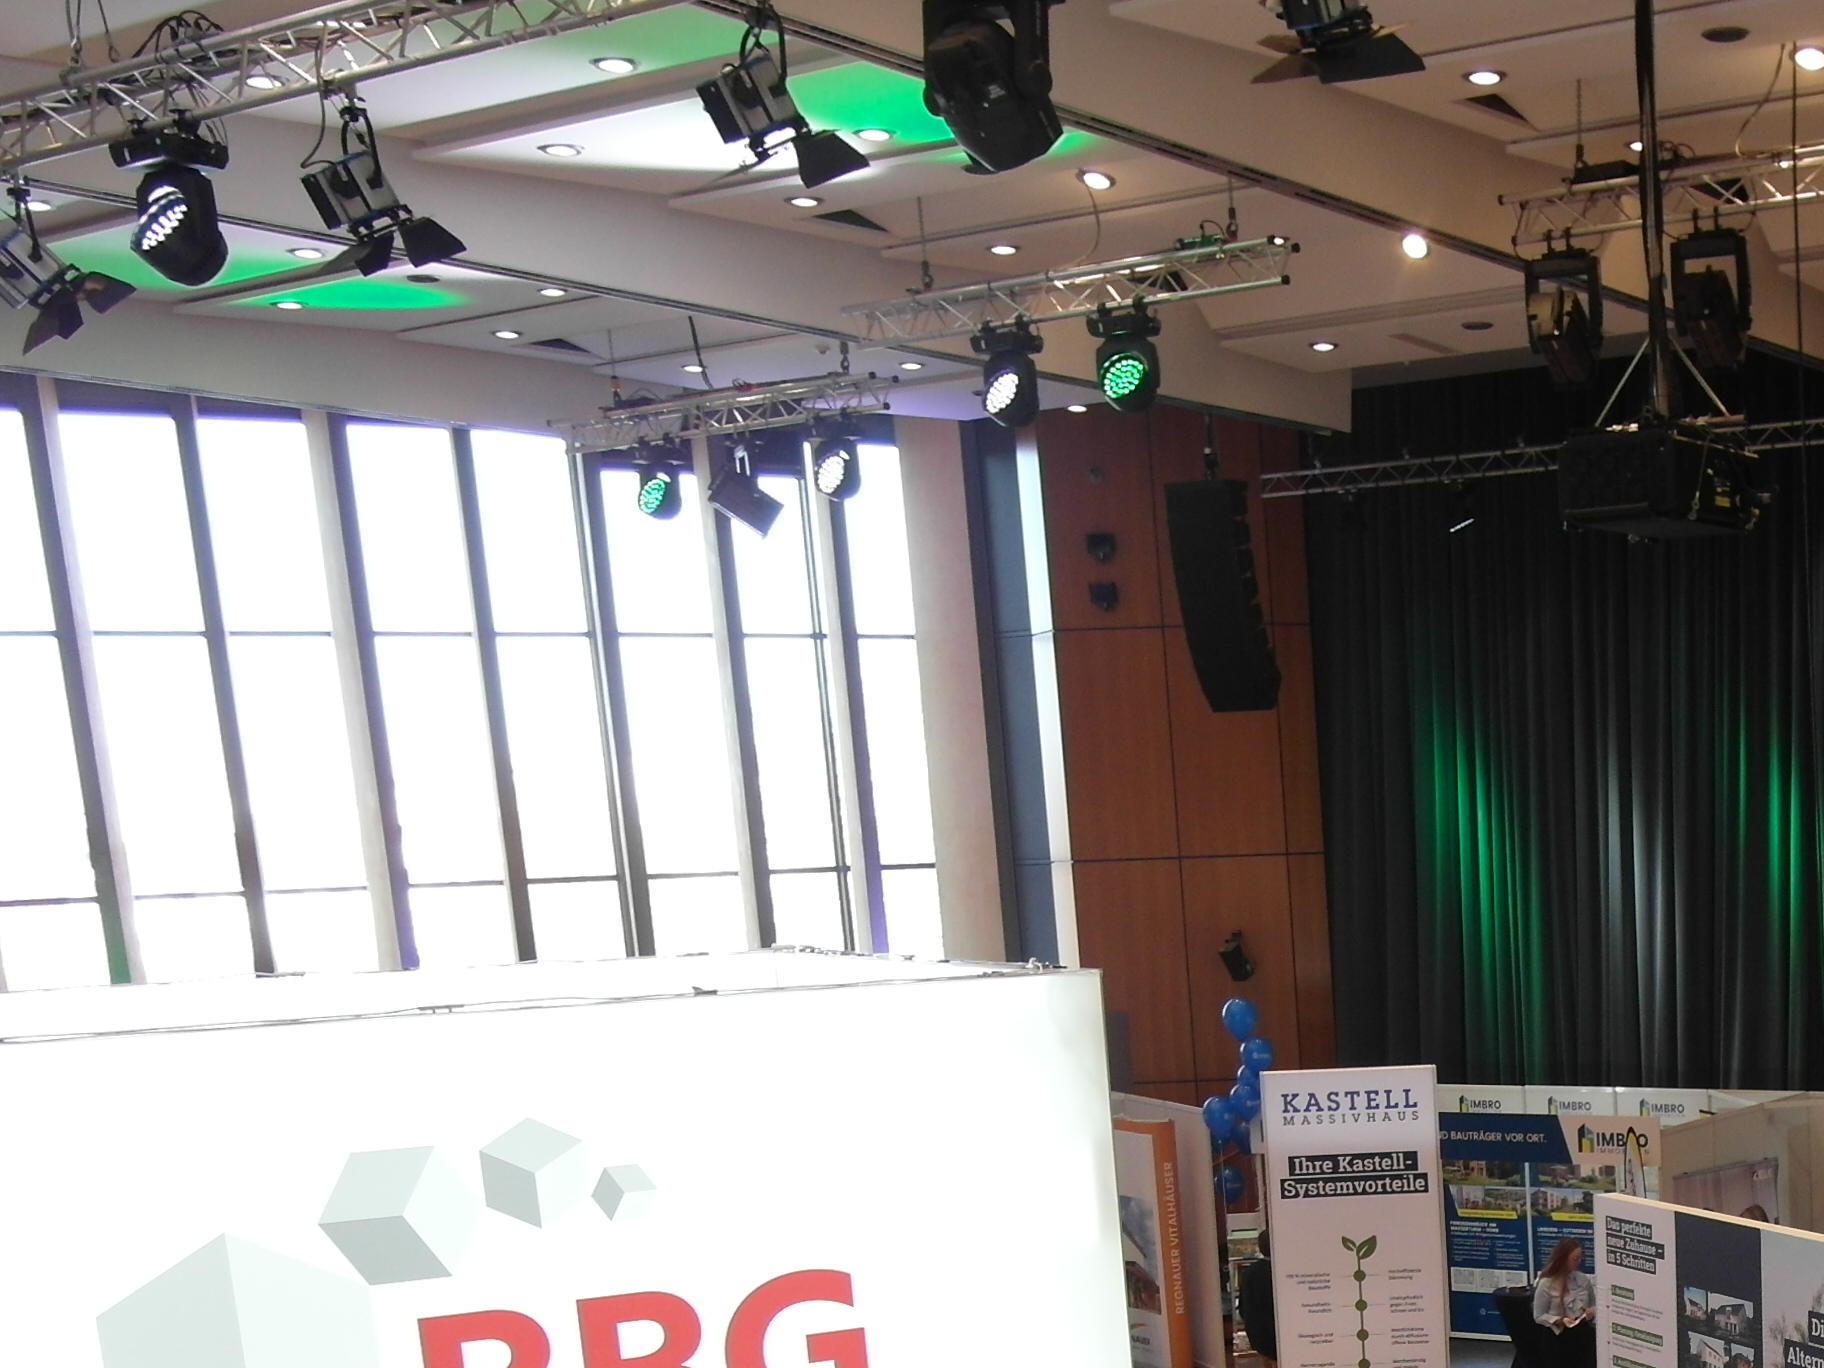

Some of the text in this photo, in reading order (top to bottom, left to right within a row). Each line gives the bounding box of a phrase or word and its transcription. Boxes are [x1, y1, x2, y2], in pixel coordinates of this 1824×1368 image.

[1281, 1088, 1418, 1114] KASTELL
[1470, 1100, 1502, 1110] IMBRO
[1559, 1101, 1592, 1111] IMBRO
[1651, 1103, 1685, 1114] IMBRO
[1283, 1111, 1419, 1126] MASSIVHAUS
[1450, 1129, 1502, 1142] BAUTRÄGER
[1505, 1133, 1524, 1143] VOR
[1526, 1133, 1547, 1144] ORT.
[1596, 1131, 1649, 1149] IMBO
[1294, 1152, 1412, 1174] Ihre Kastell-
[1284, 1174, 1426, 1198] Systemvorteile
[1607, 1218, 1651, 1237] Das perfekte
[1163, 1161, 1185, 1315] REGNAUER VITALHÄUSER
[1608, 1236, 1625, 1248] neue
[1625, 1239, 1656, 1255] Zuhause
[1608, 1250, 1655, 1272] in 5 Schritten
